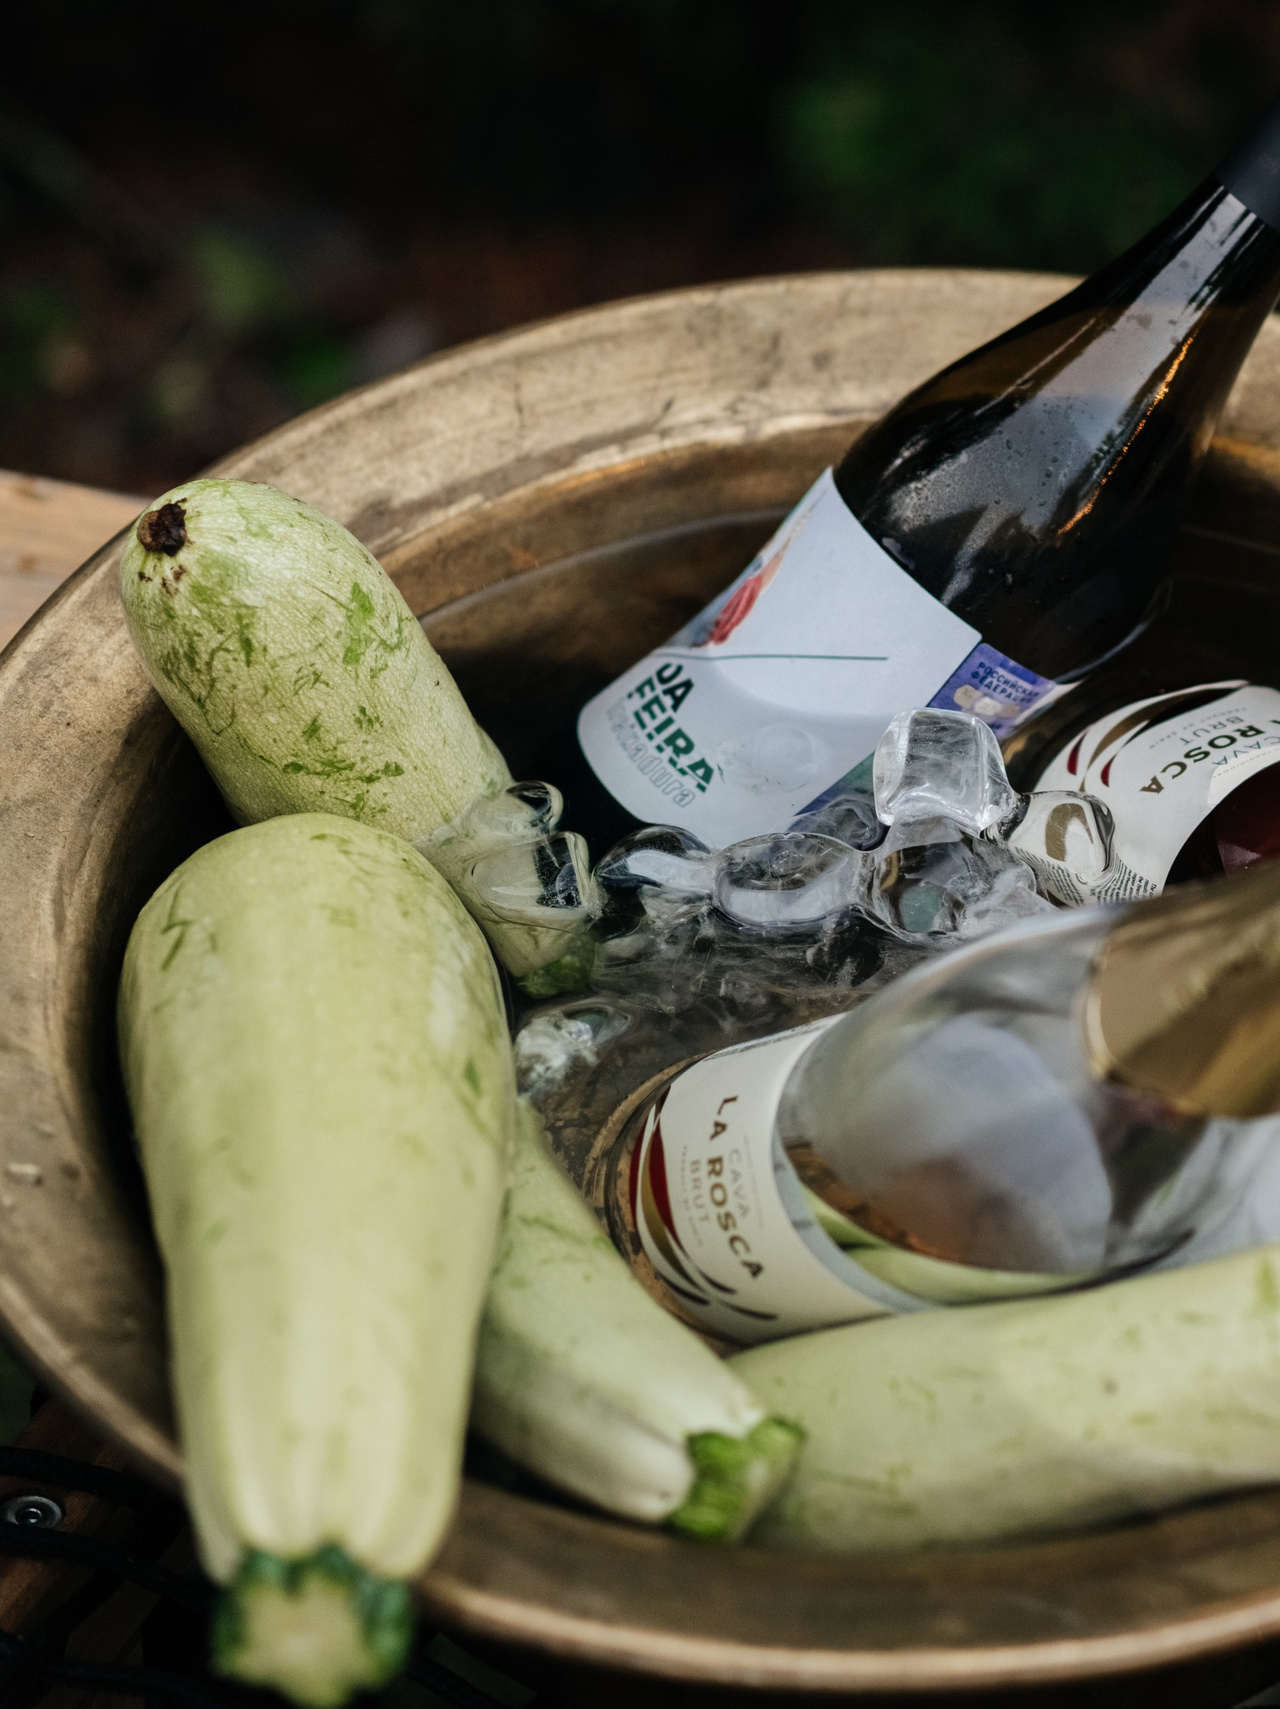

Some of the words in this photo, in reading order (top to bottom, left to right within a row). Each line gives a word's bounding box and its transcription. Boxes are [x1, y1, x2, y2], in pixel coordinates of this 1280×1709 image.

[970, 669, 1033, 703] ФЕДЕРАЦИЯ
[976, 660, 1040, 697] РОССИЙСКАЯ
[626, 675, 715, 793] FEIRA
[1138, 724, 1266, 794] ROSCA
[1179, 715, 1244, 746] BRUT
[709, 1094, 740, 1141] LA
[689, 1159, 711, 1224] BRUT
[728, 1147, 752, 1219] CAVA
[706, 1155, 766, 1279] ROSCA
